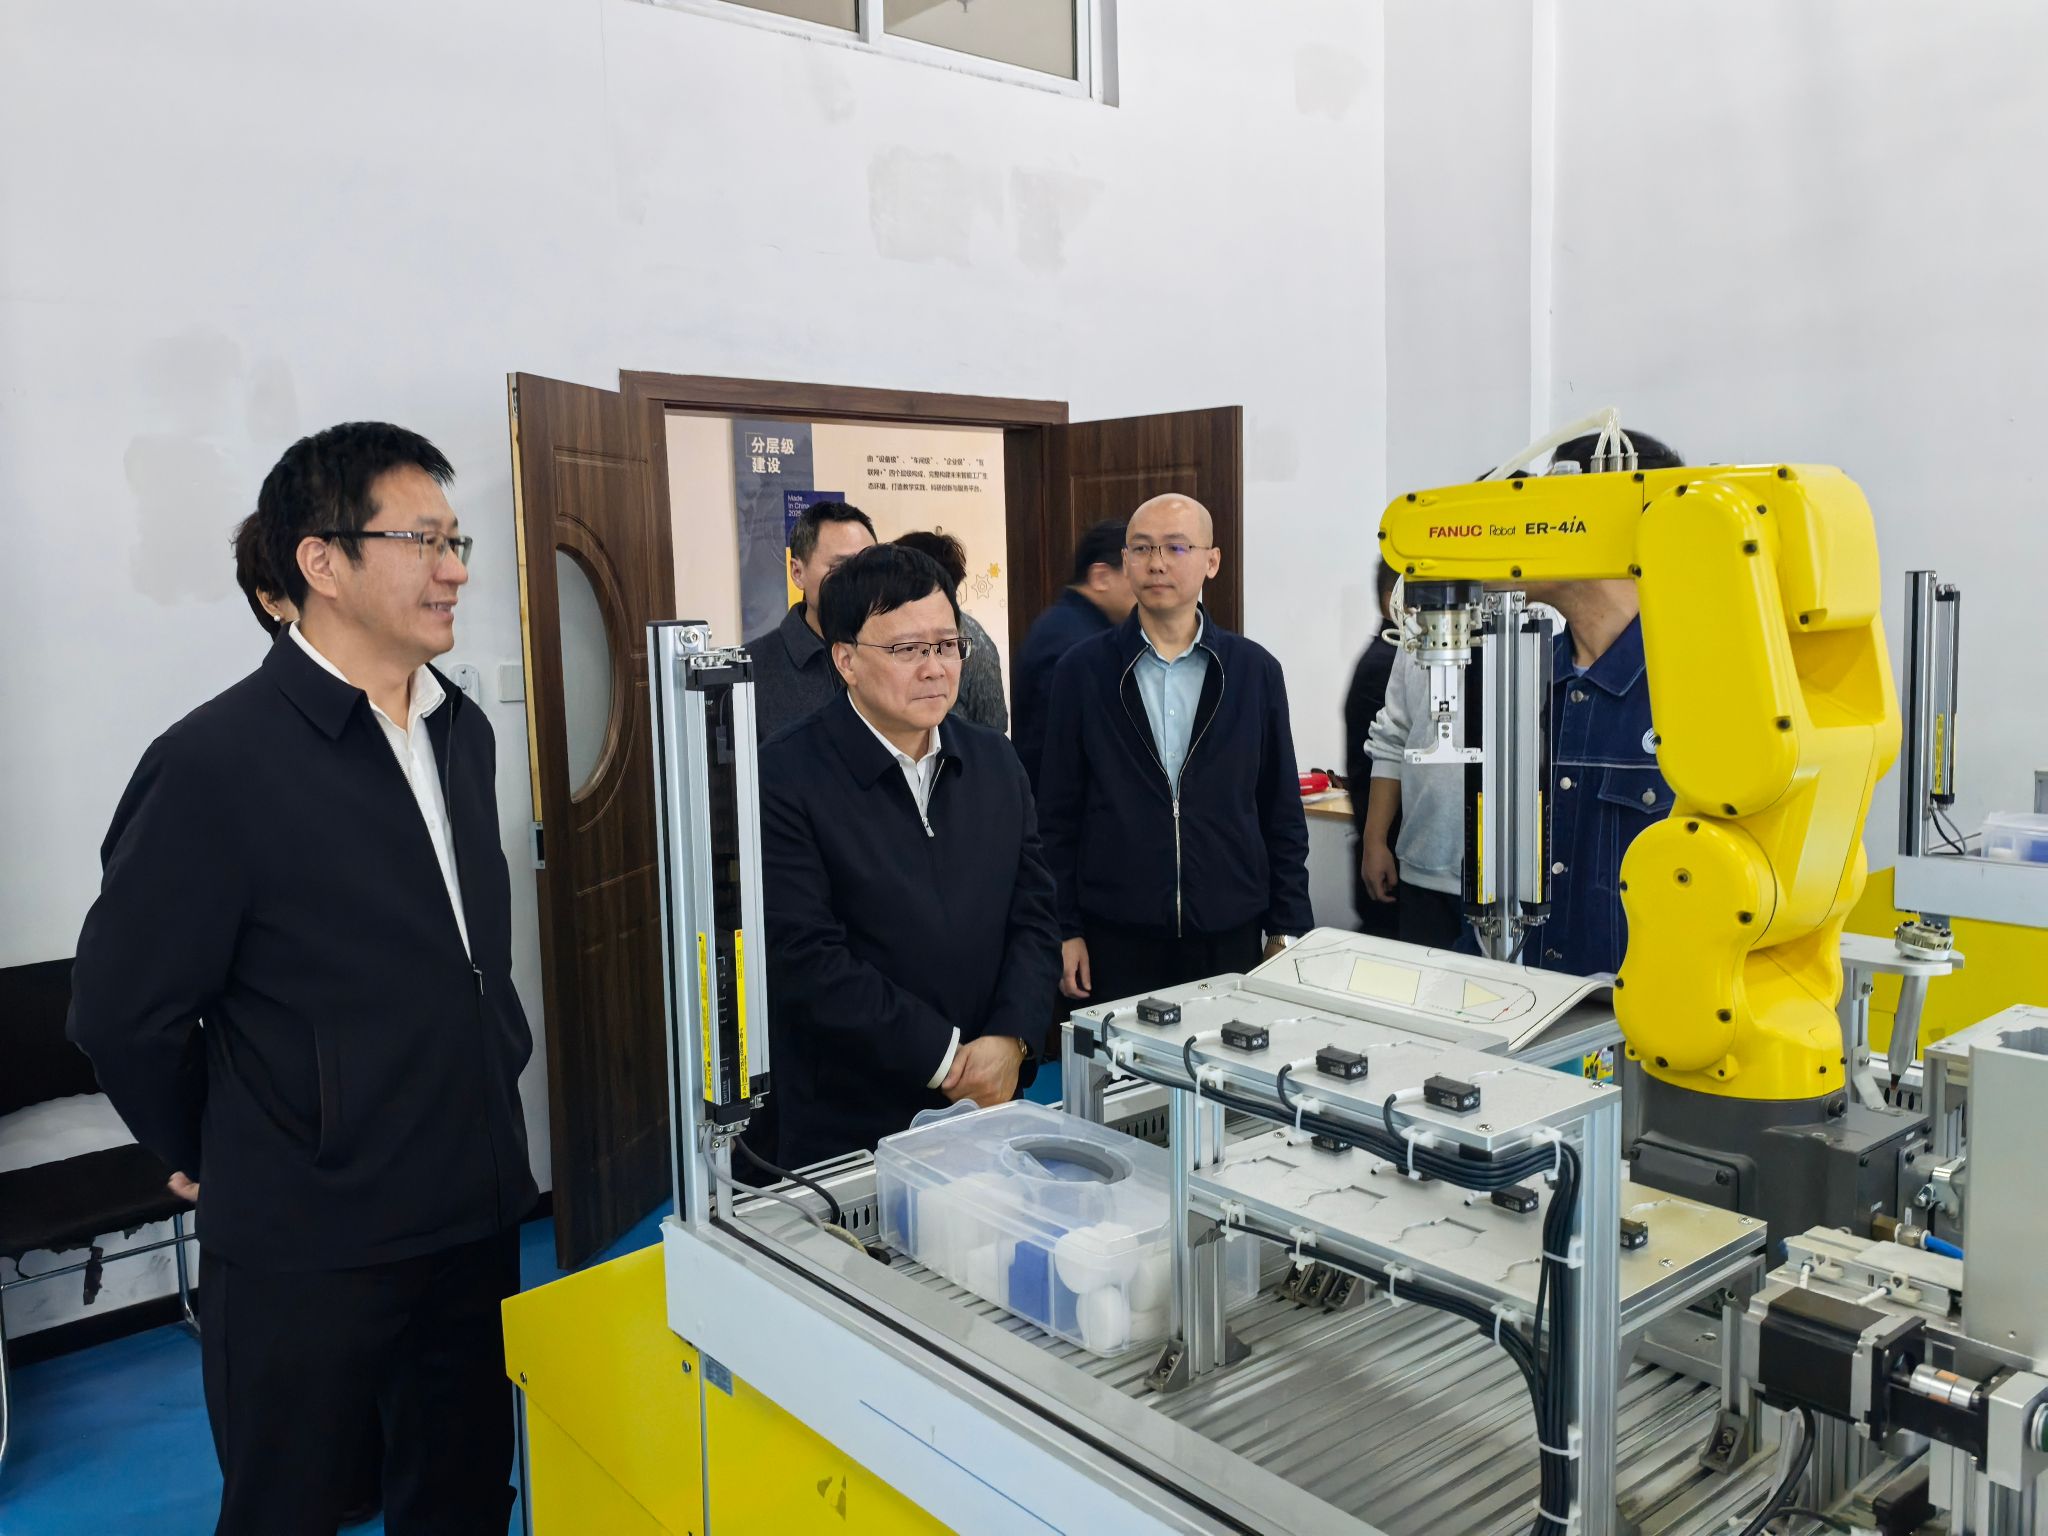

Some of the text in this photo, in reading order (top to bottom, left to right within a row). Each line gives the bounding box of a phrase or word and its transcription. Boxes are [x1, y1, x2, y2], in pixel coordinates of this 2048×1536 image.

[751, 436, 795, 455] 分层级
[751, 457, 781, 474] 建设
[787, 493, 803, 502] Made
[1429, 516, 1587, 538] FANUC Robot ER-4iA
